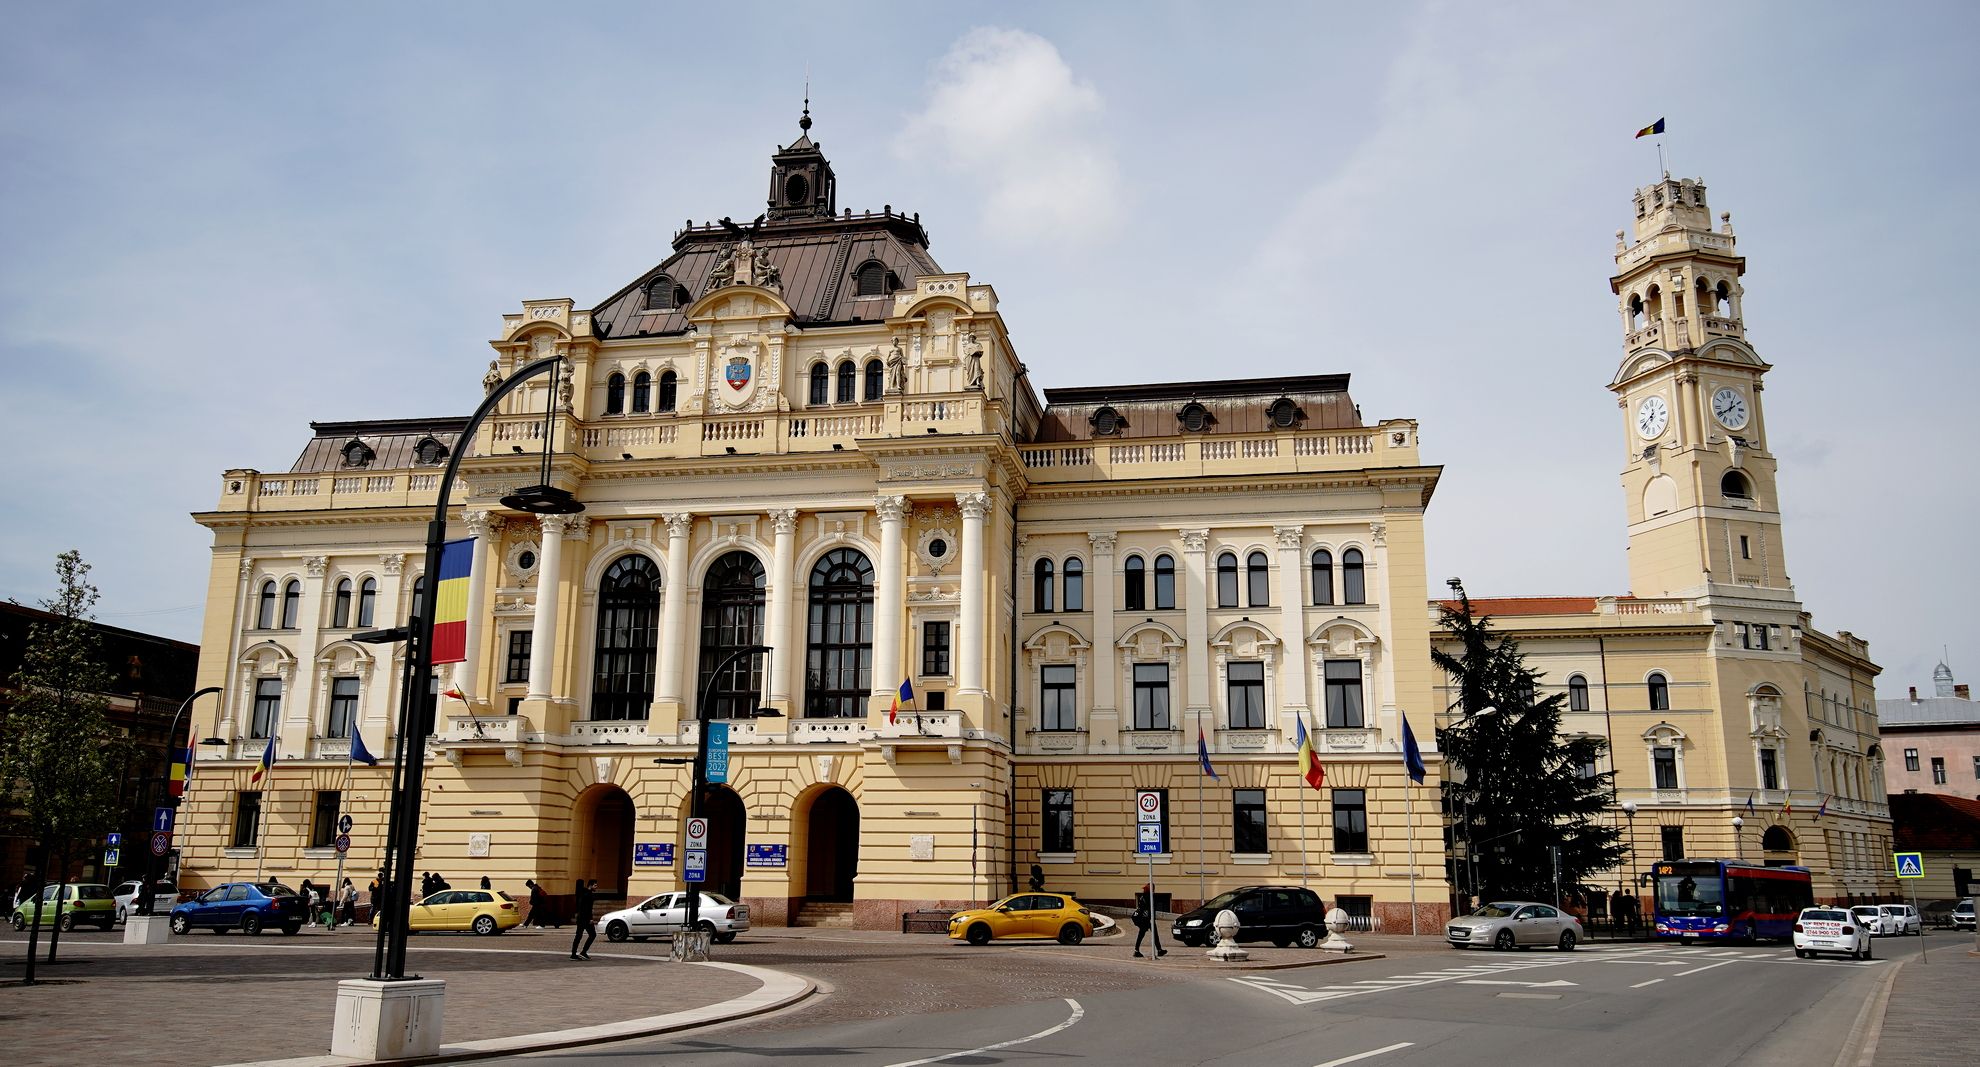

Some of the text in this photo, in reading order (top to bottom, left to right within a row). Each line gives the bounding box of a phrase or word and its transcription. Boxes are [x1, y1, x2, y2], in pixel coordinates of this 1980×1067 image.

[708, 752, 726, 760] BEST
[708, 762, 726, 771] 2022
[1144, 798, 1154, 807] 20
[691, 824, 702, 834] 20
